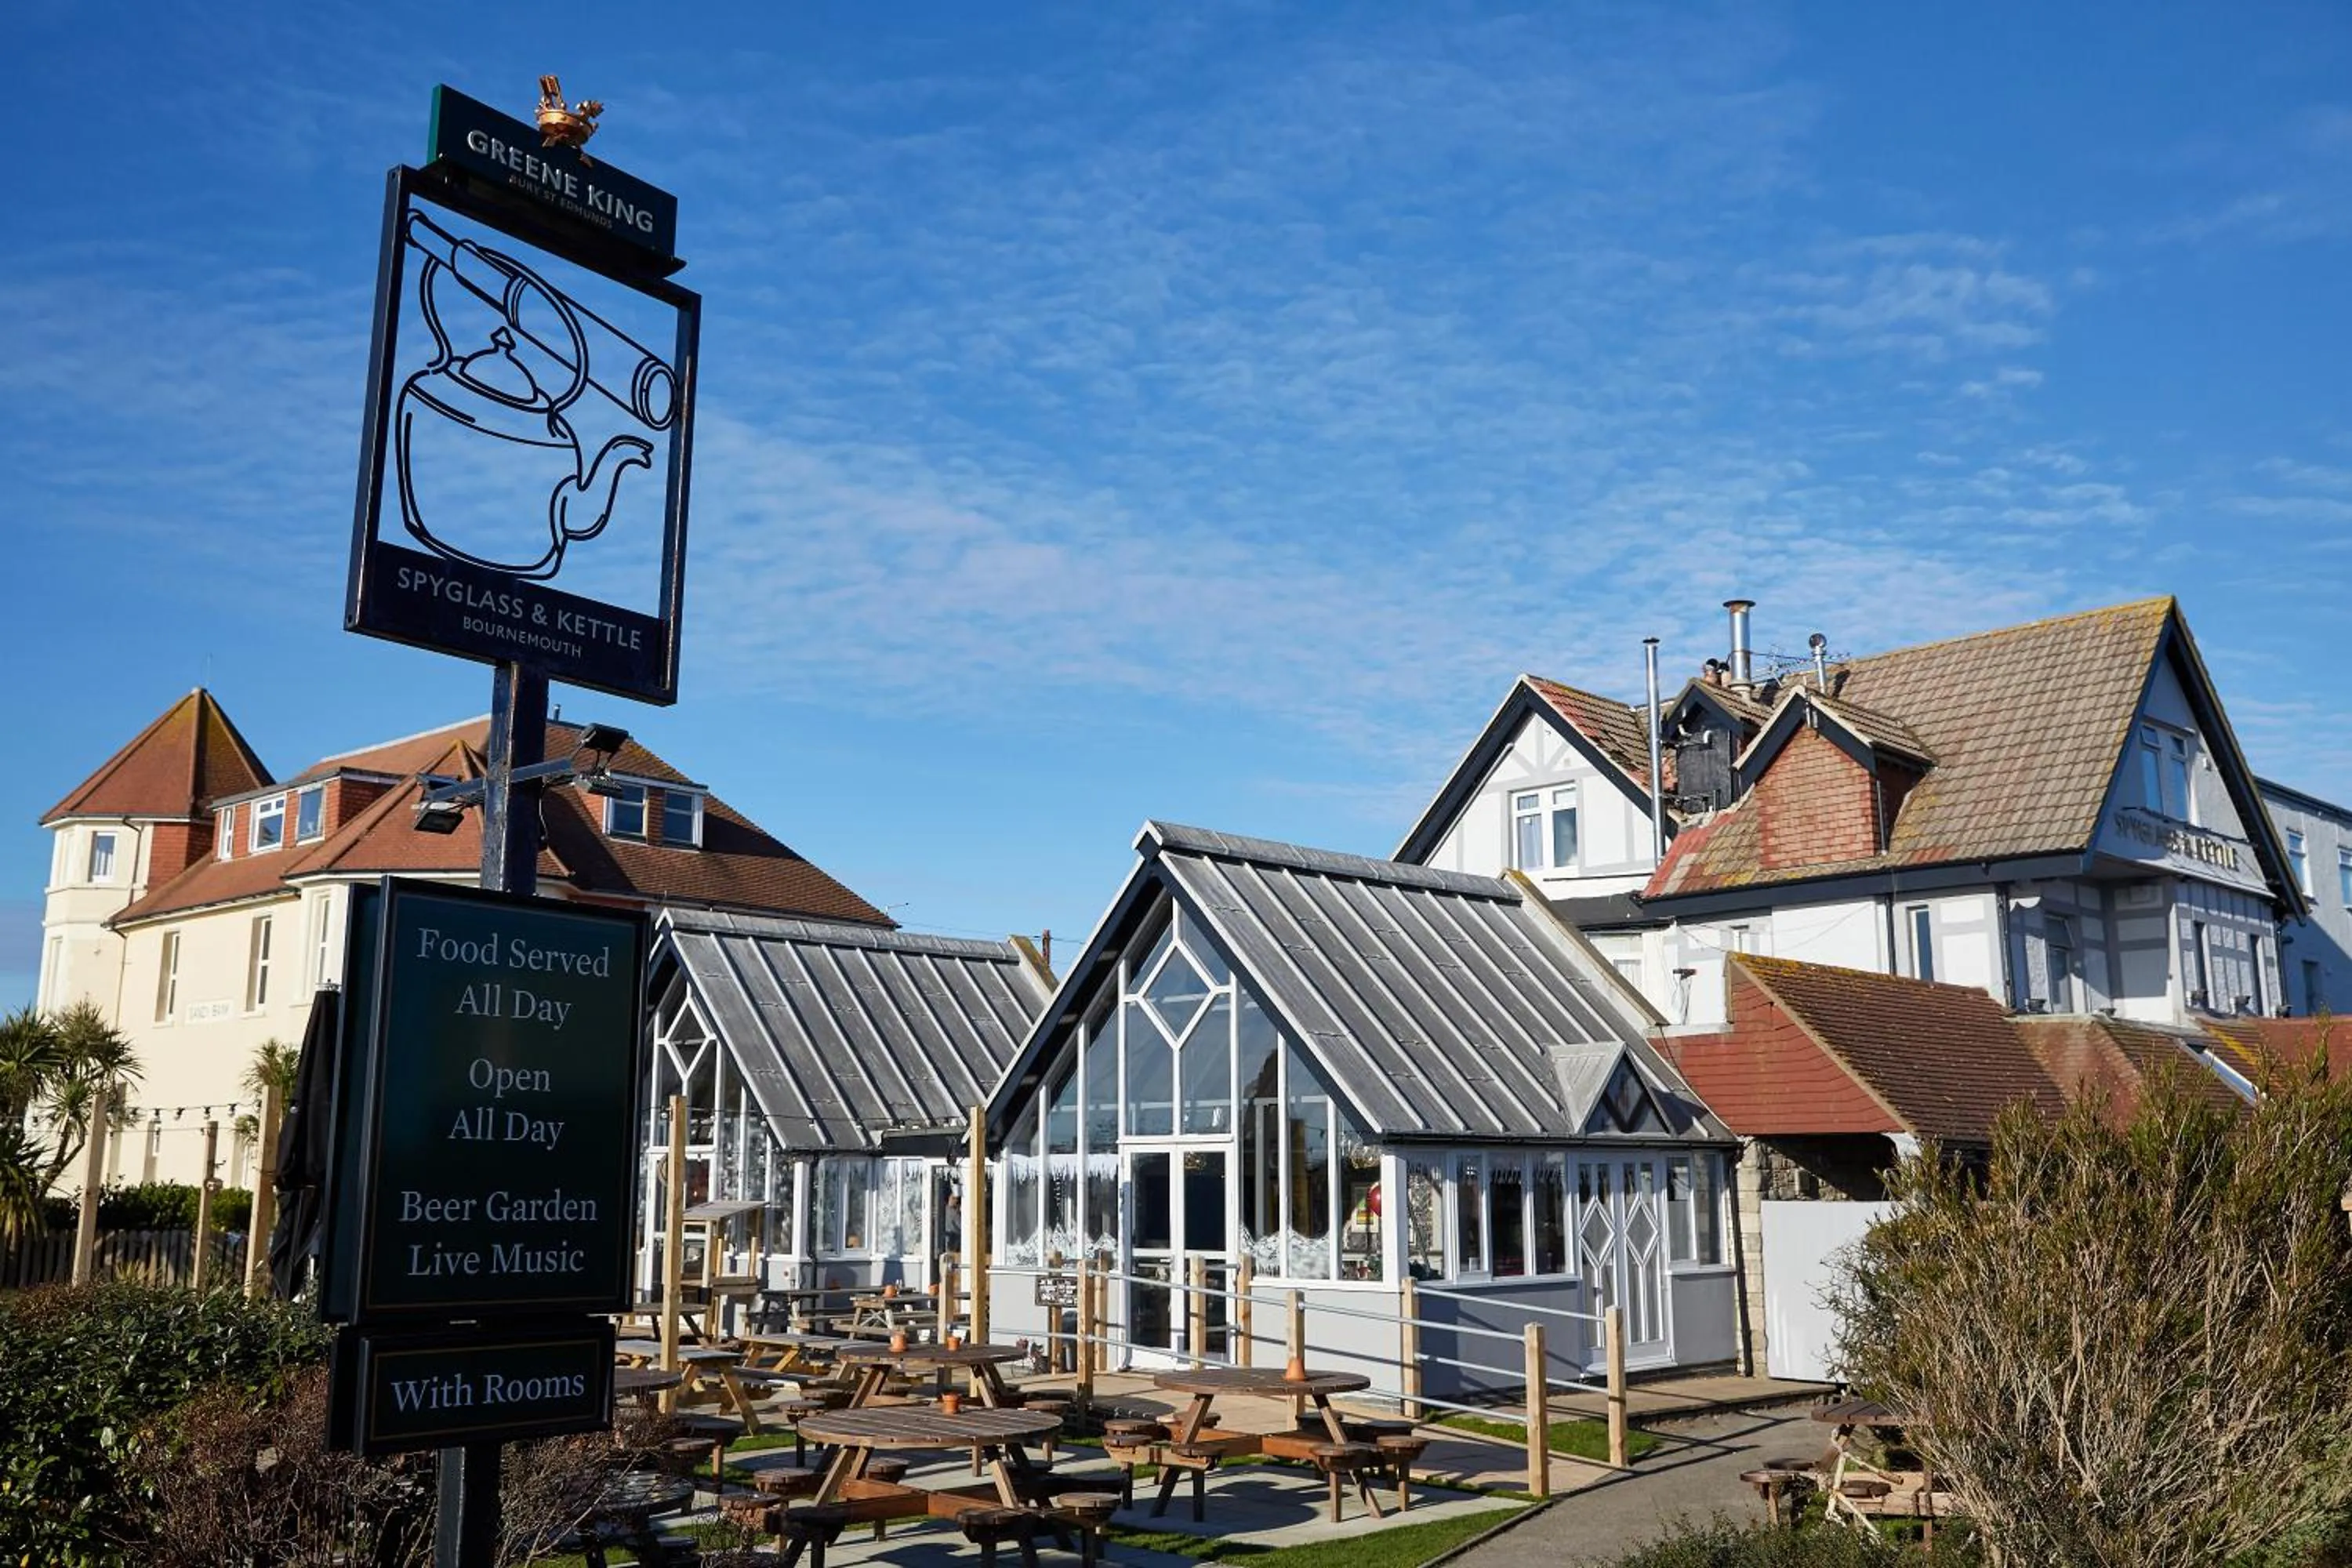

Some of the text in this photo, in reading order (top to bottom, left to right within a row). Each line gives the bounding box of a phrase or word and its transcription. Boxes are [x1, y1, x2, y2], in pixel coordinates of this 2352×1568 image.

[466, 130, 653, 232] GREENE KING
[397, 567, 641, 651] SPYGLASS & KETTLE
[463, 616, 581, 659] BOURNEMOUTH
[416, 927, 609, 978] Food Served
[455, 982, 572, 1030] All Day
[469, 1058, 550, 1097] Open
[448, 1106, 565, 1151] All Day
[399, 1188, 597, 1222] Beer Garden
[407, 1240, 584, 1276] Live Music
[390, 1373, 584, 1411] With Rooms
